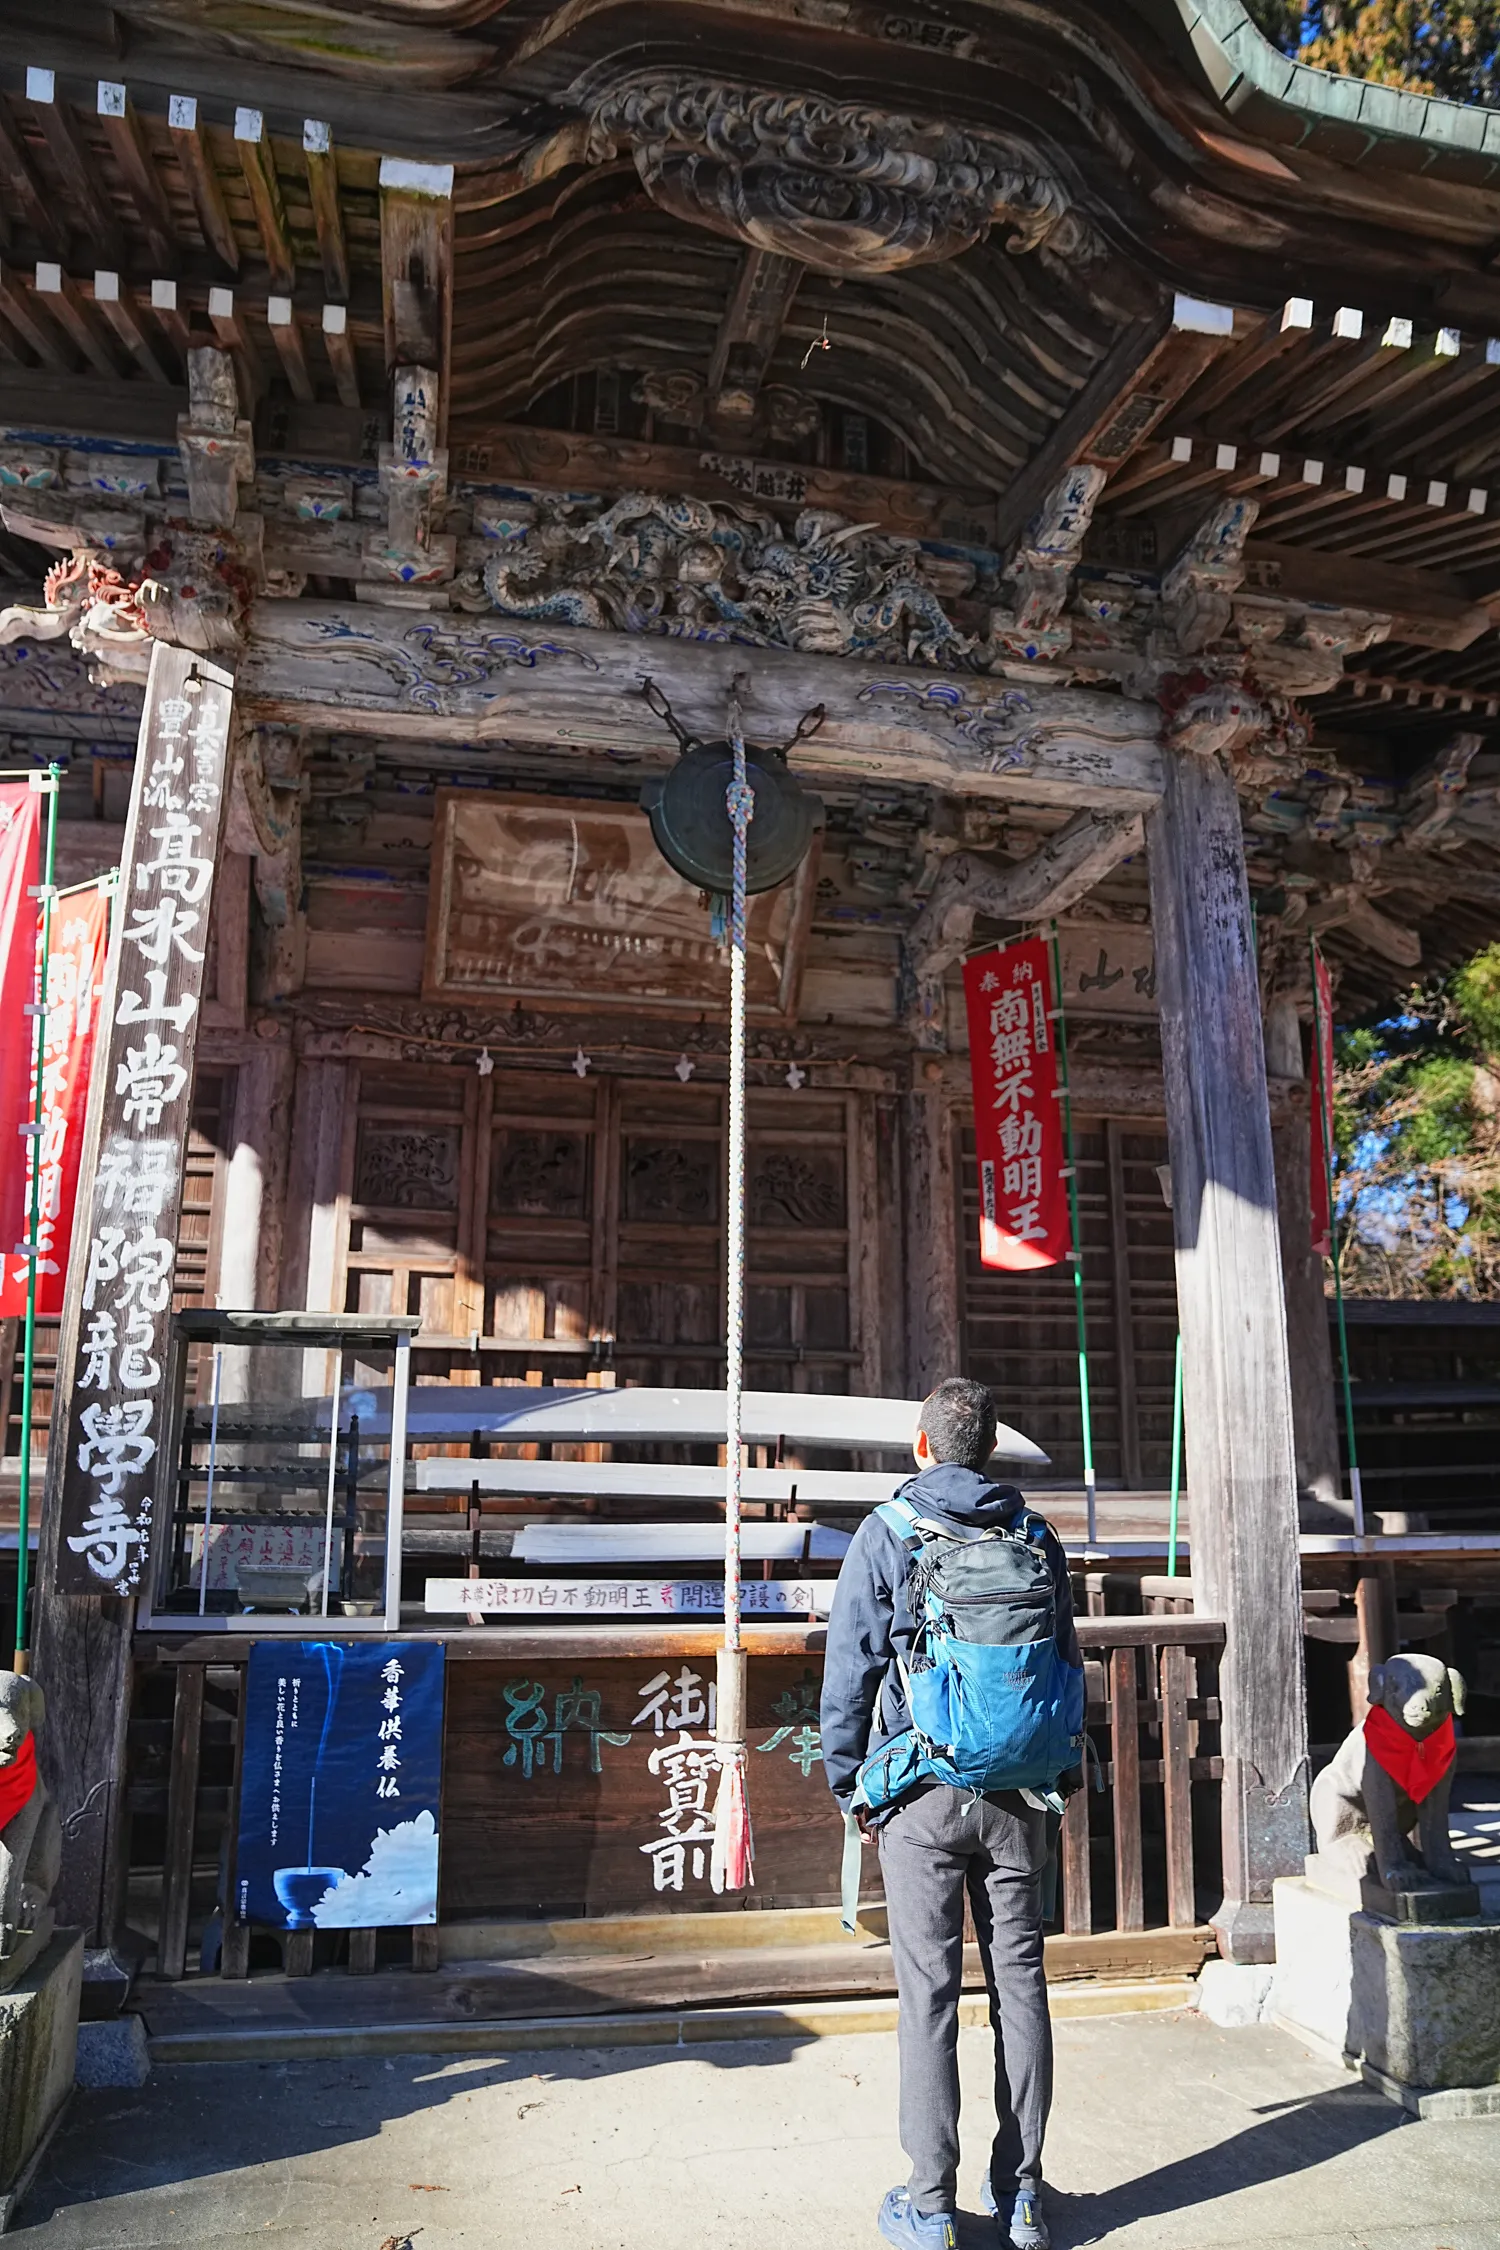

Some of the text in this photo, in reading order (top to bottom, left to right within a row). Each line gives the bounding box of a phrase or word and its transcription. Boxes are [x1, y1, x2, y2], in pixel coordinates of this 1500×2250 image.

[989, 989, 1048, 1246] 南無不動明王
[376, 1658, 405, 1798] 香華供養仏
